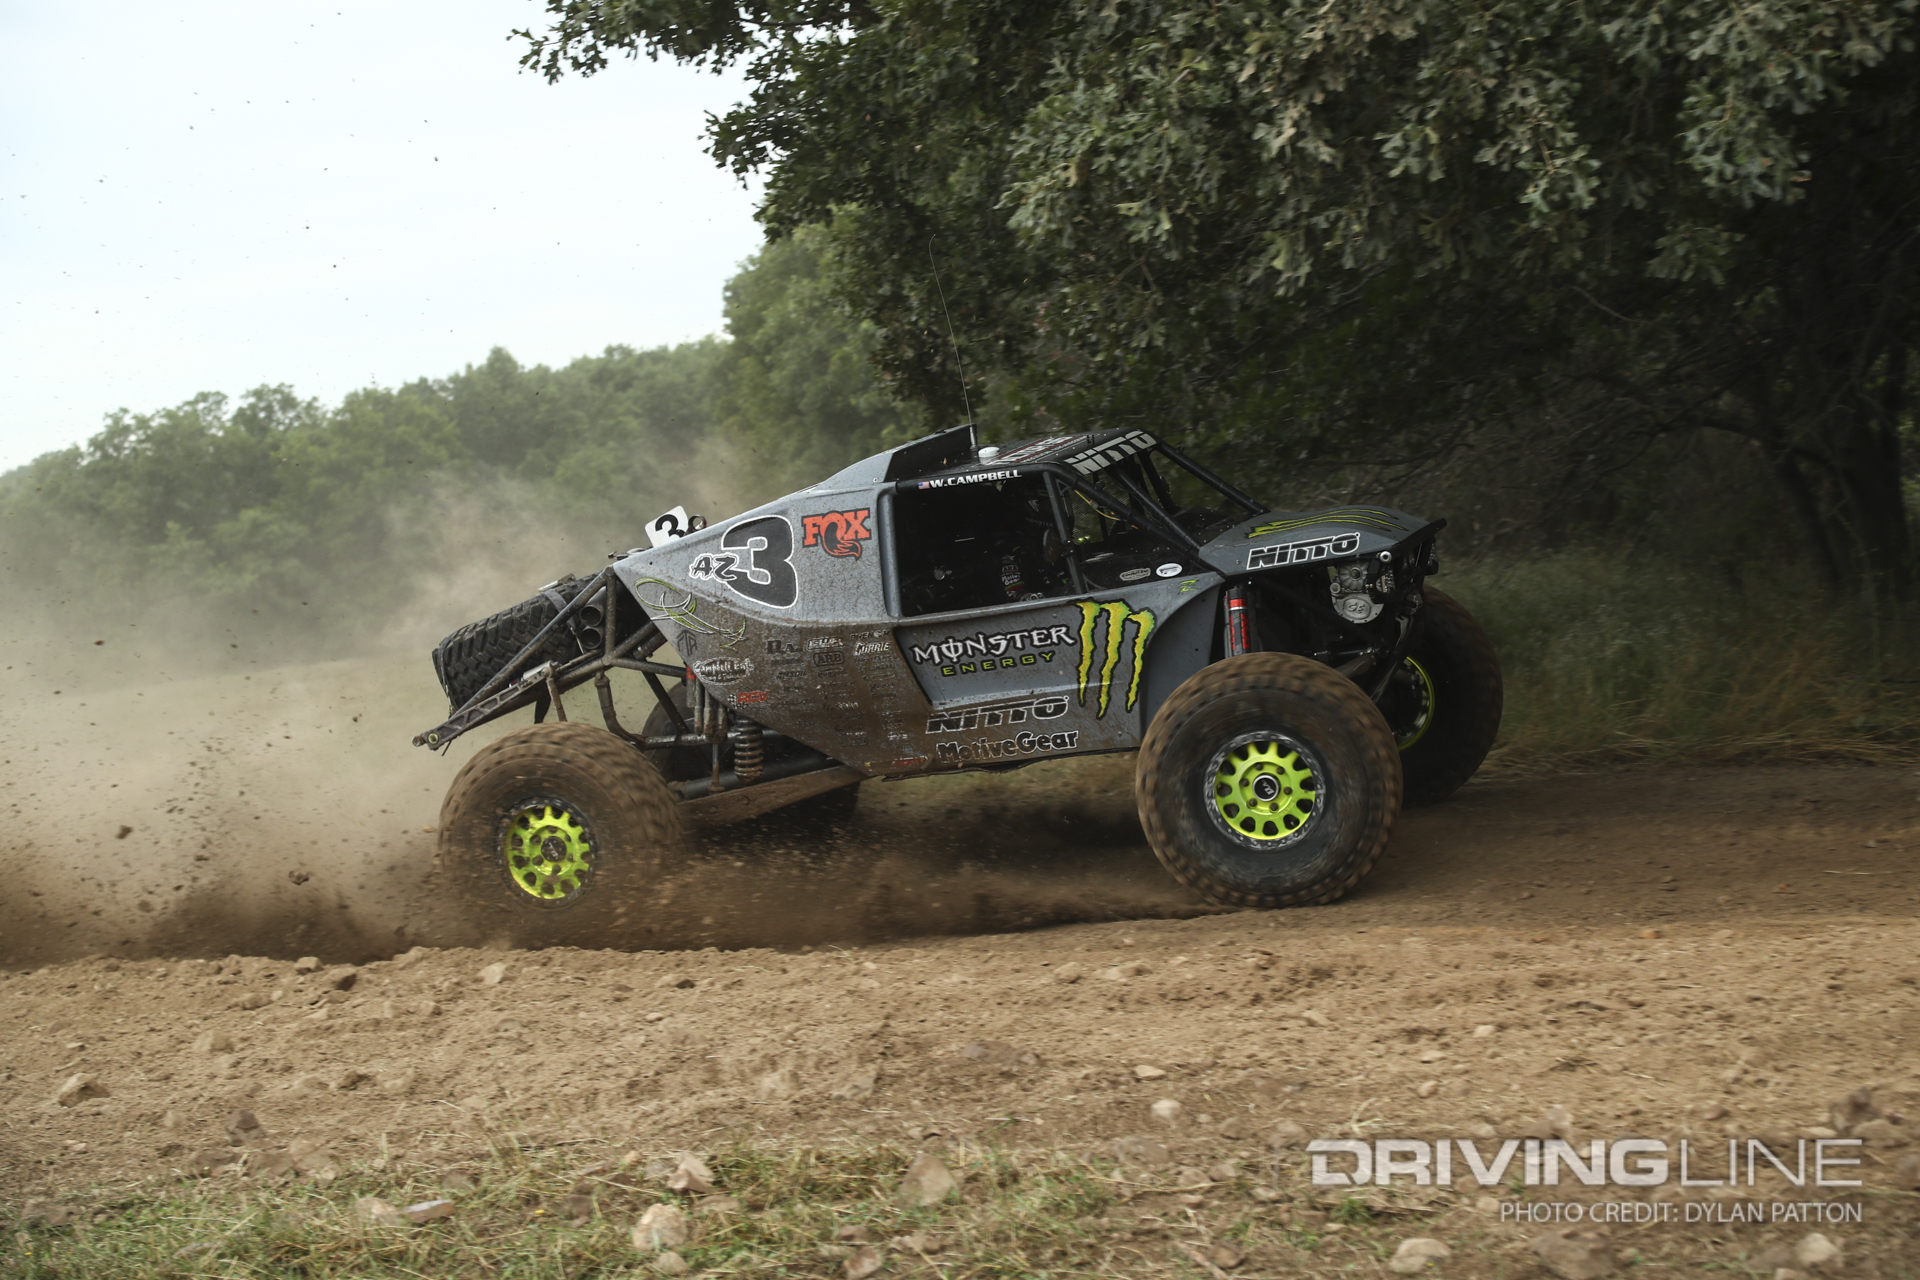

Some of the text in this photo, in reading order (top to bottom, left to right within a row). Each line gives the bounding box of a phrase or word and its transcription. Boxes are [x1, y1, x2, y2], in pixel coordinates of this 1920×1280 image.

[1064, 429, 1157, 476] NITTO
[929, 469, 1022, 489] W.CAMPBELL
[654, 513, 686, 540] 3
[801, 507, 872, 560] FOX
[689, 552, 740, 584] AZ
[721, 514, 799, 609] 3
[1246, 532, 1361, 571] NITTO
[816, 652, 842, 665] ARB
[912, 625, 1076, 665] MONSTER
[942, 651, 1054, 676] ENERGY
[737, 690, 770, 704] RCV
[925, 695, 1069, 735] NITTO
